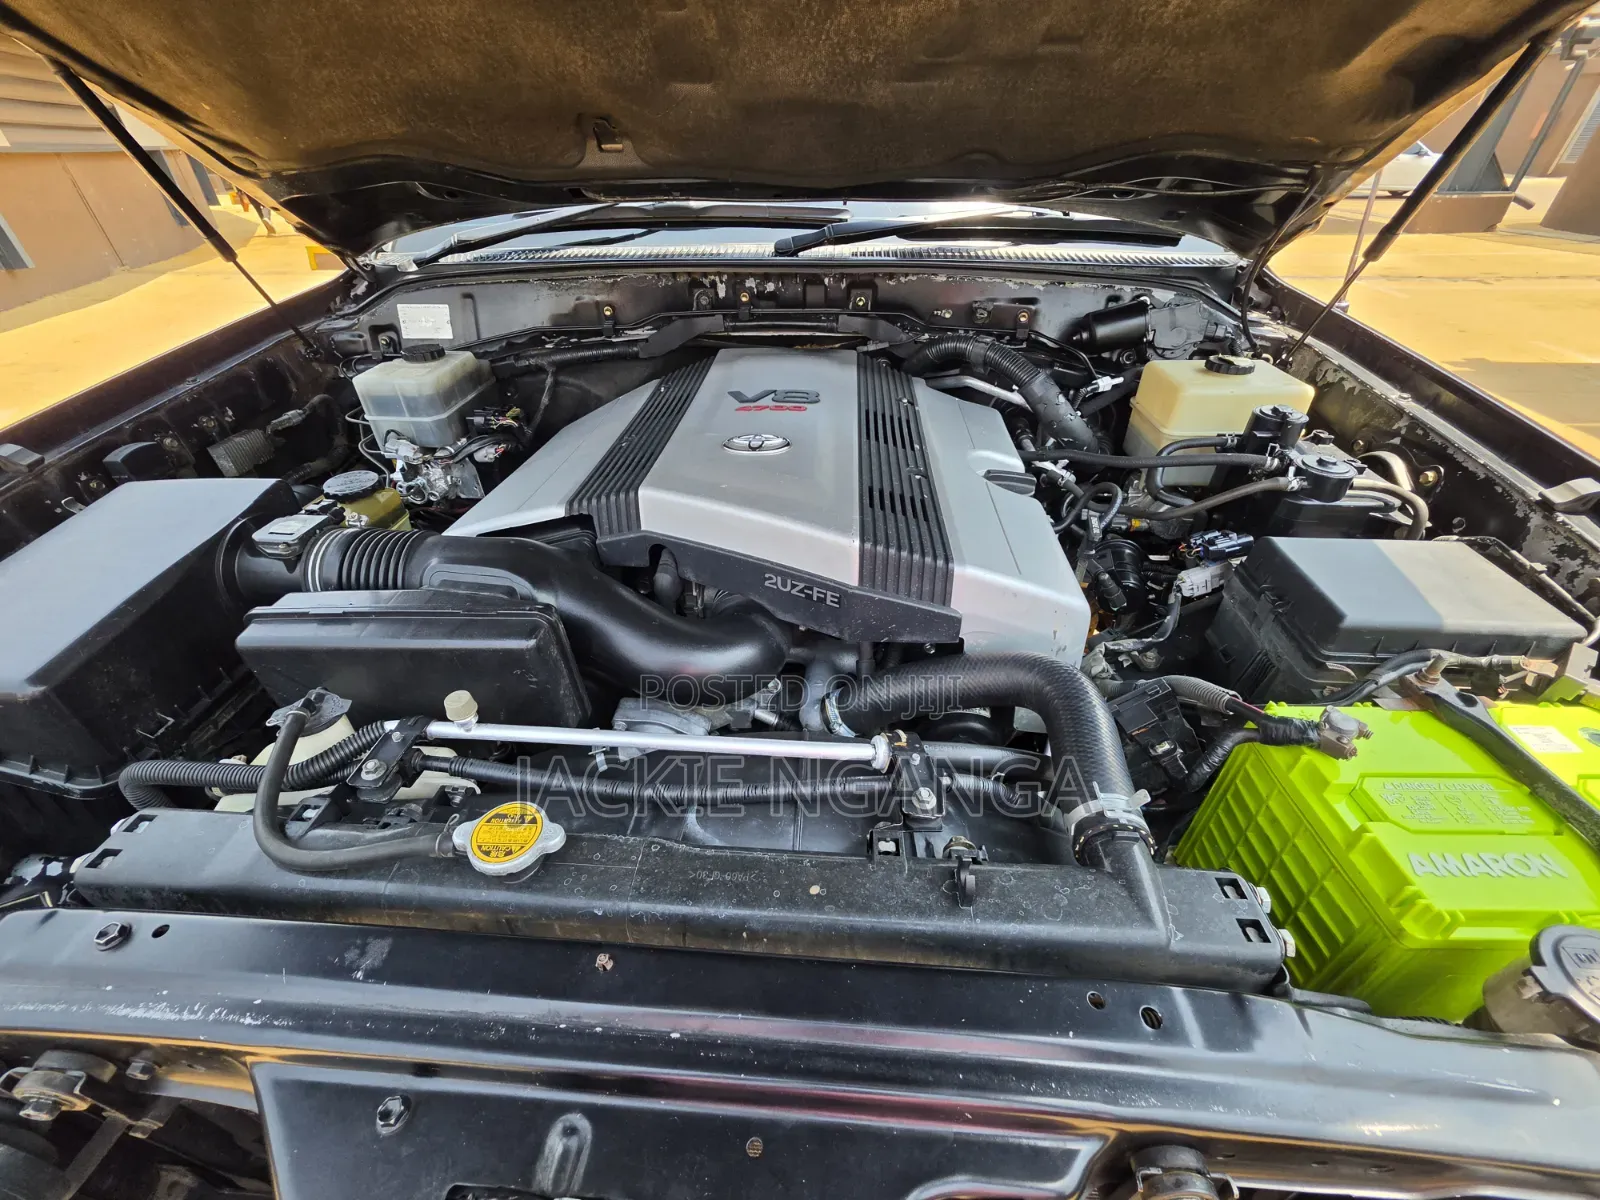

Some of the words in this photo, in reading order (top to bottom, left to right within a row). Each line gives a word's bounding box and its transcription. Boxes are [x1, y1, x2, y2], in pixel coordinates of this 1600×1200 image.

[727, 389, 821, 404] V8
[764, 573, 840, 608] 2UZ-FE
[1408, 852, 1568, 878] AMARON
